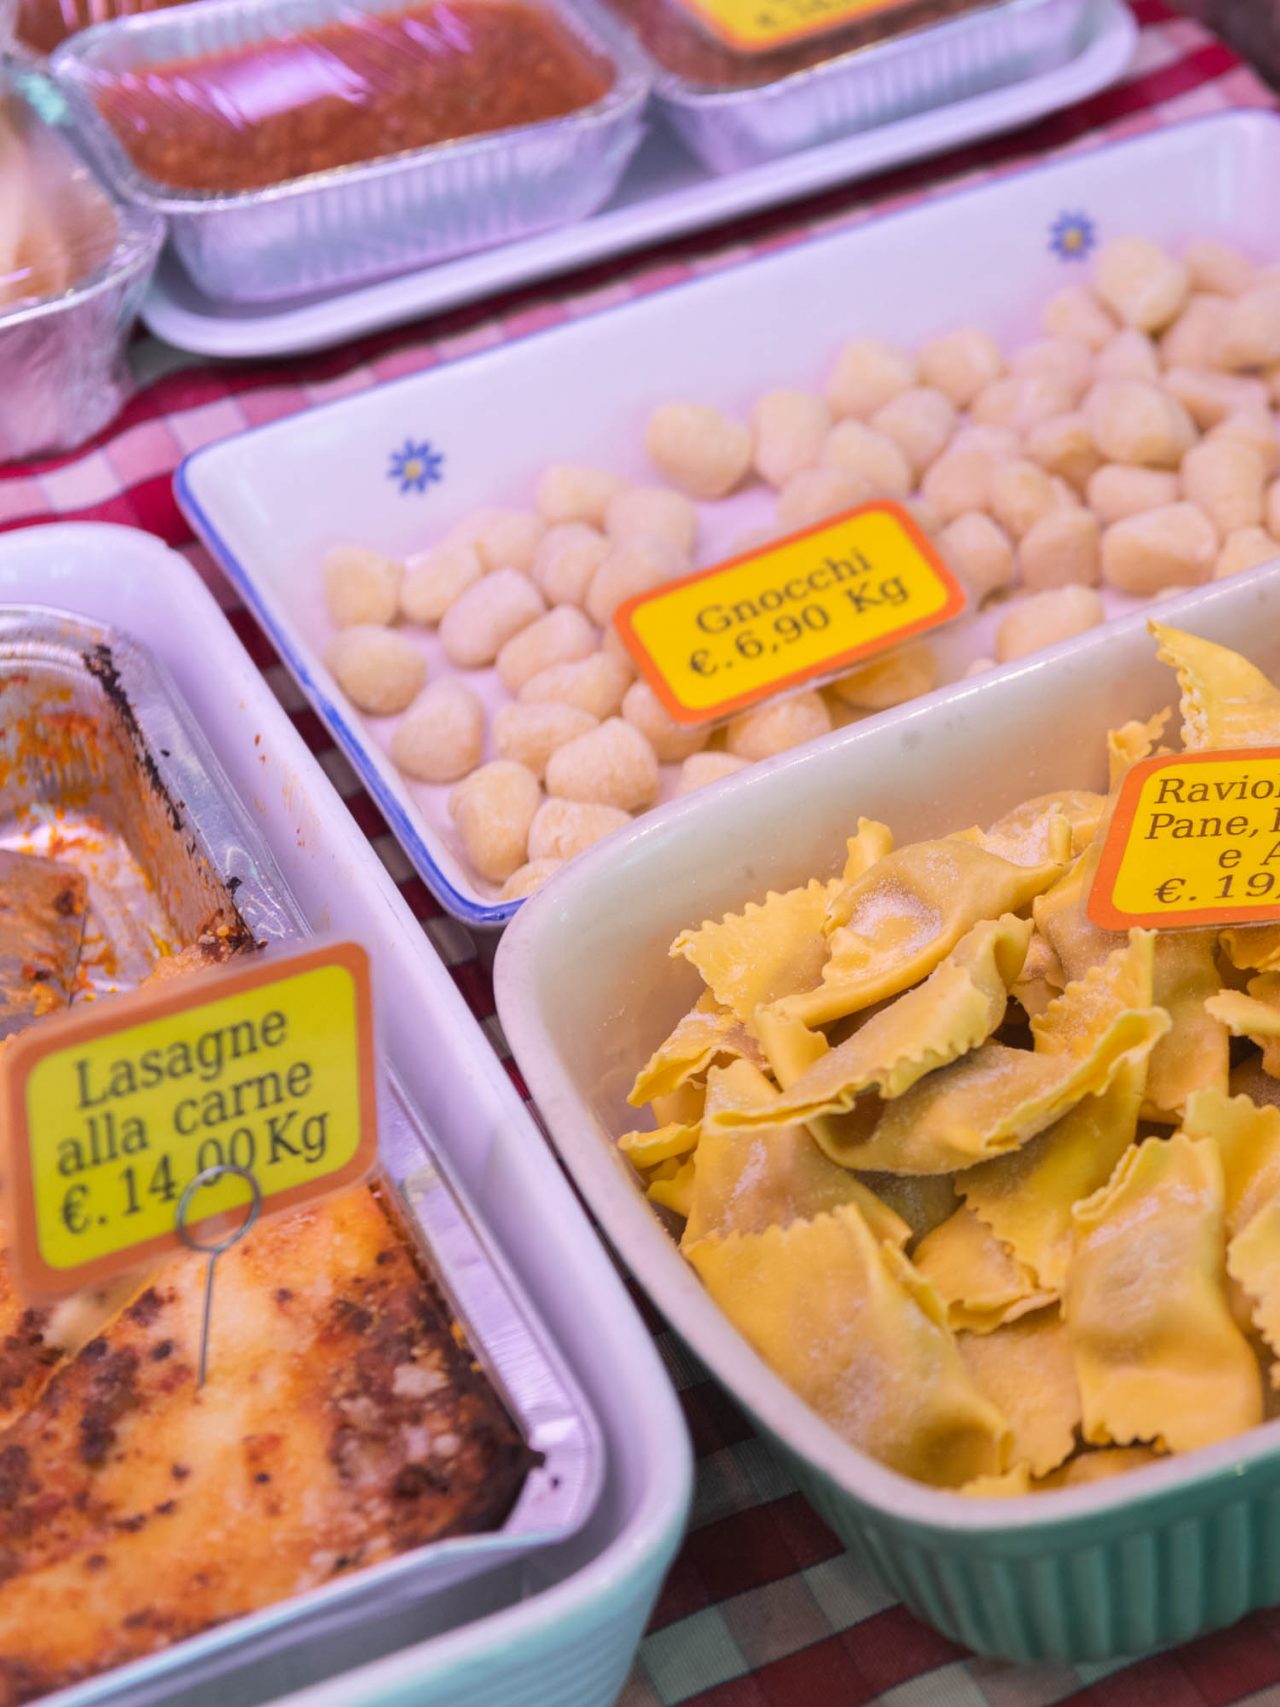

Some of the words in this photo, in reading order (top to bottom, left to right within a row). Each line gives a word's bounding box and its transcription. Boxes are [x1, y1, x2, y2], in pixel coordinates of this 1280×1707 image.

[696, 547, 873, 634] Gnocchi
[844, 575, 909, 614] Kg
[1216, 848, 1244, 869] e
[74, 1009, 288, 1112] Lasagne
[56, 1111, 150, 1179] alla
[173, 1059, 314, 1137] carne
